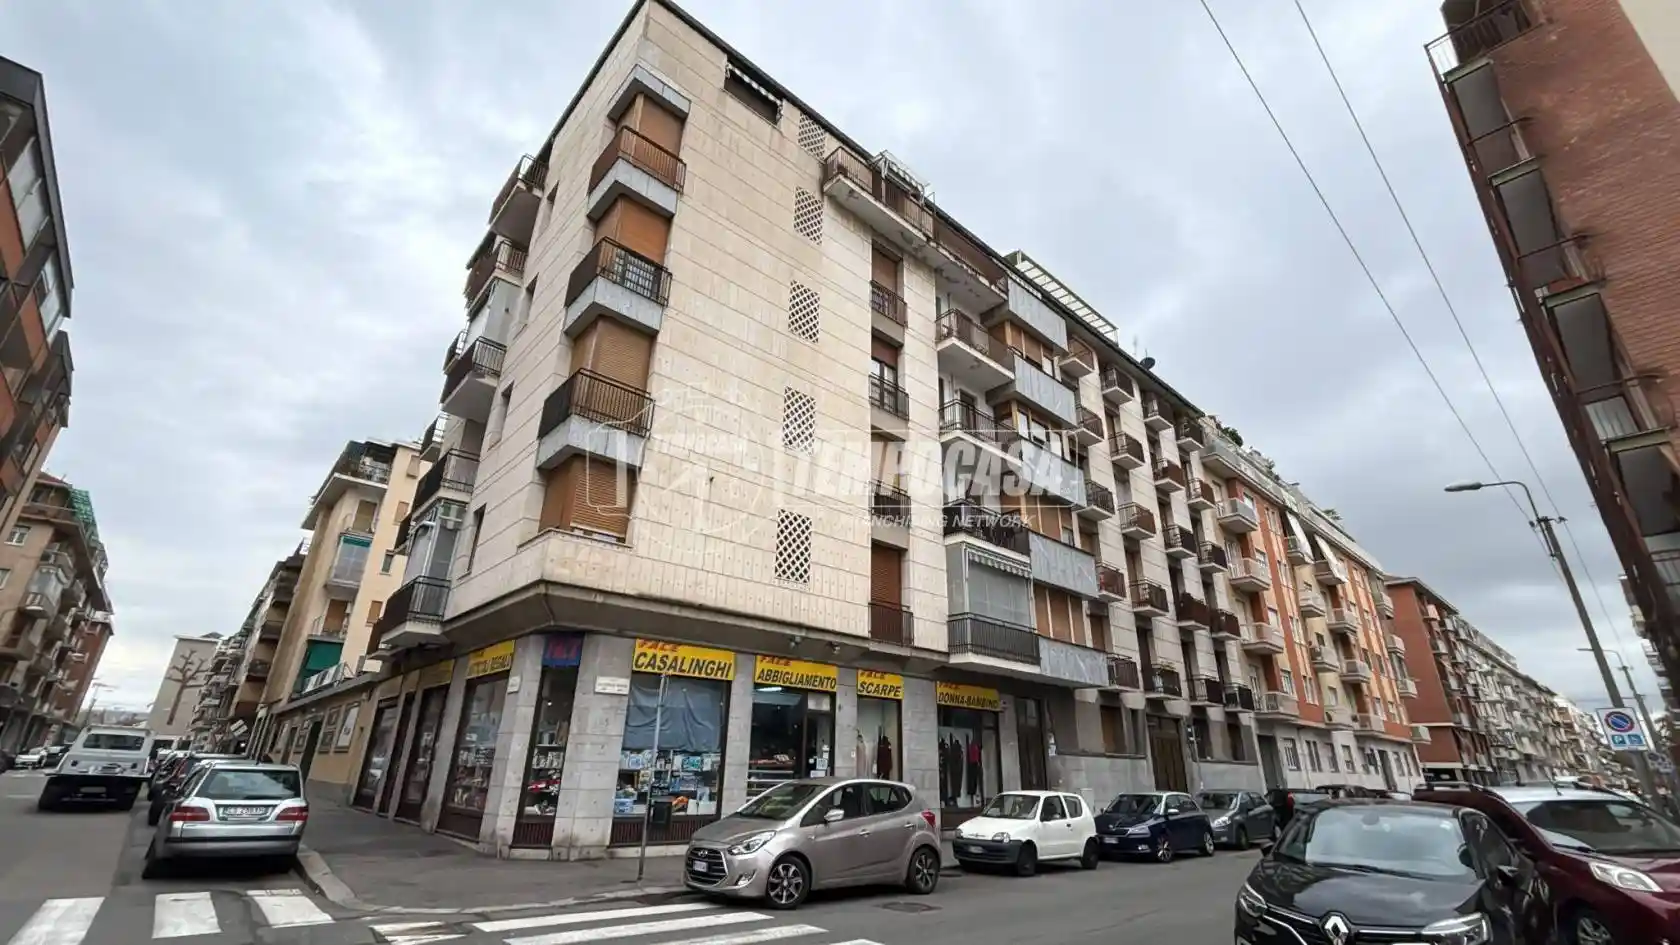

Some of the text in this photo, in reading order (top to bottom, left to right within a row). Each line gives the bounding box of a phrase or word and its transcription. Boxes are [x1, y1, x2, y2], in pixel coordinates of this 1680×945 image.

[634, 652, 732, 679] CASALINGHI
[756, 668, 837, 690] ABBIGLIAMENTO
[858, 680, 902, 697] SCARPE
